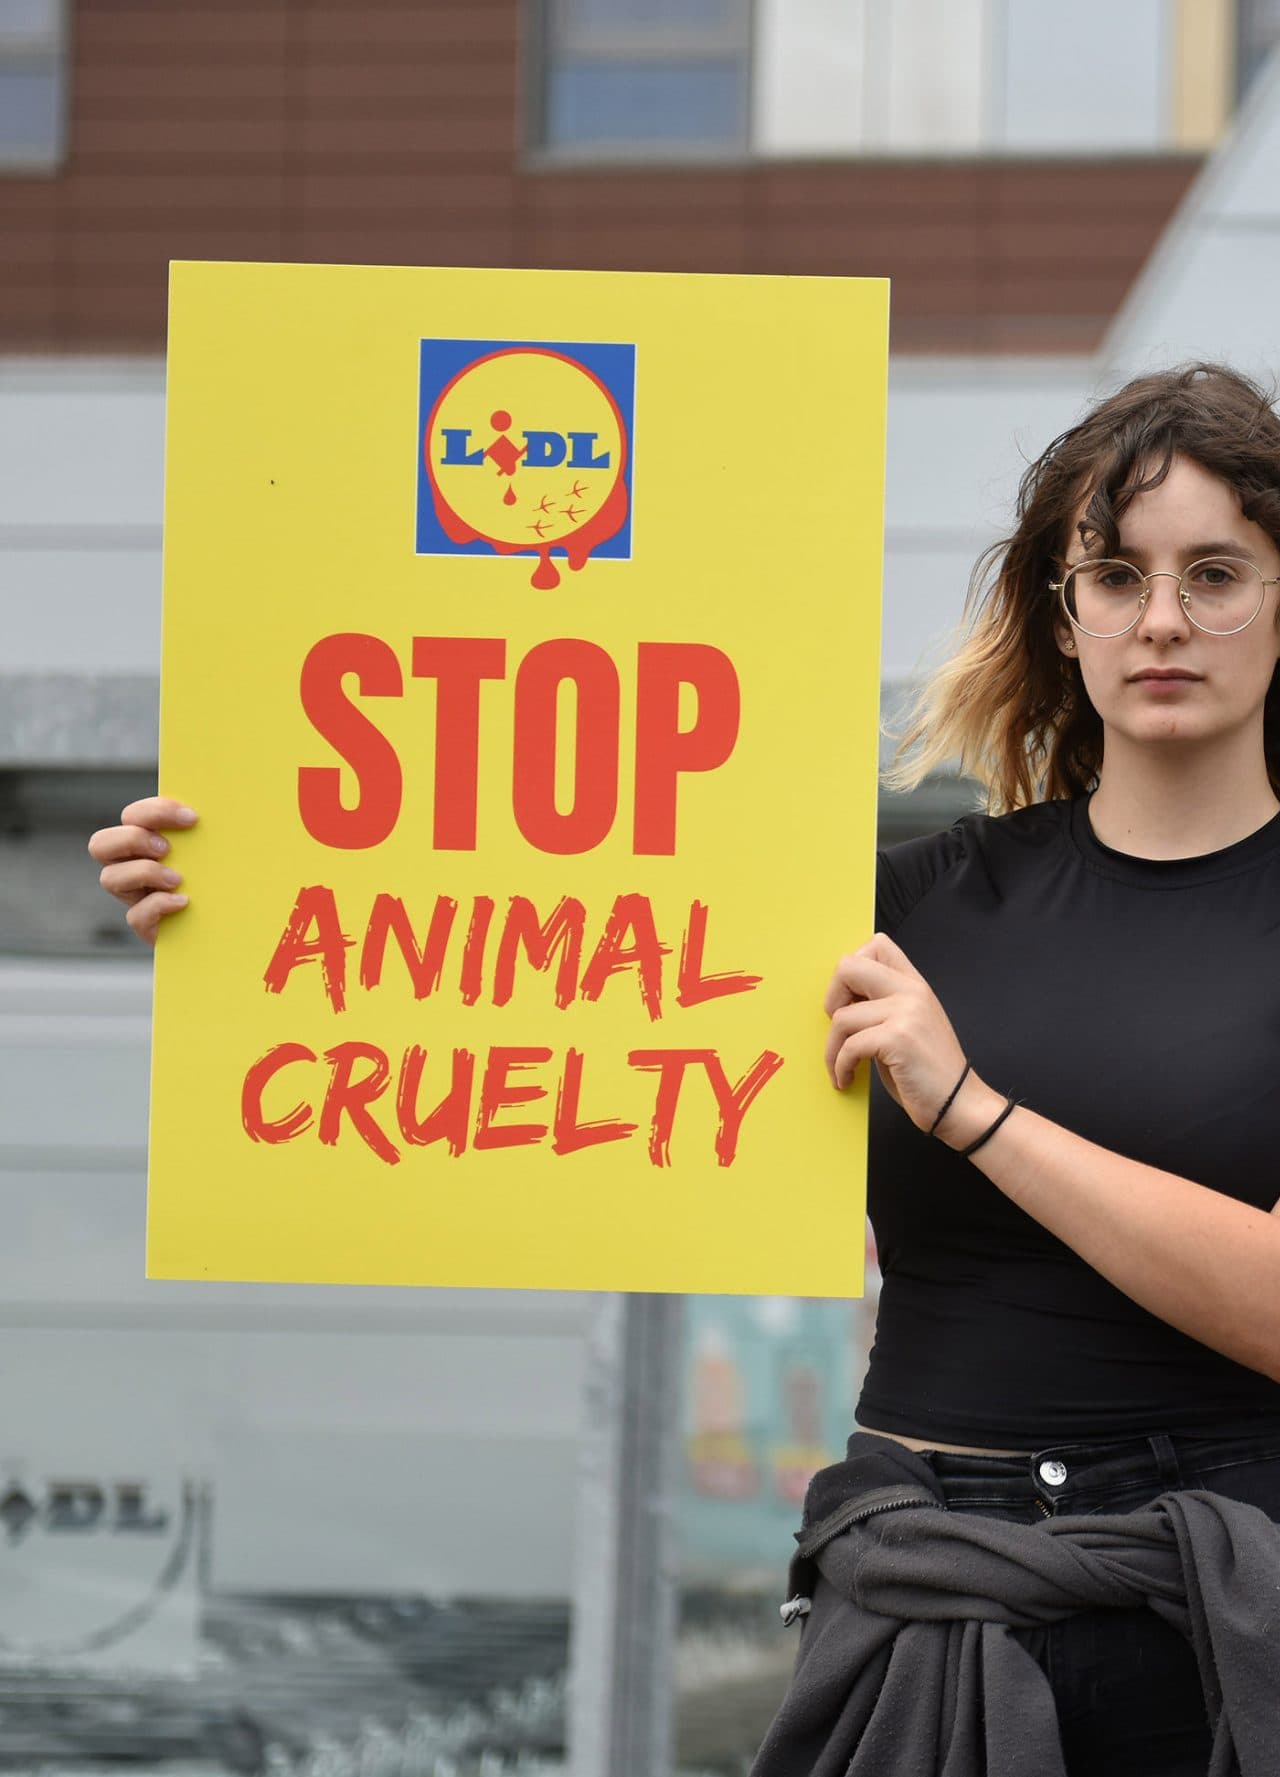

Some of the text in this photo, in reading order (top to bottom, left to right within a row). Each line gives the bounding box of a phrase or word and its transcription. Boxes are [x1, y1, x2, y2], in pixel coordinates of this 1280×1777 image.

[297, 632, 741, 856] STOP
[263, 885, 763, 1022] ANIMAL
[241, 1041, 784, 1168] CRUELTY
